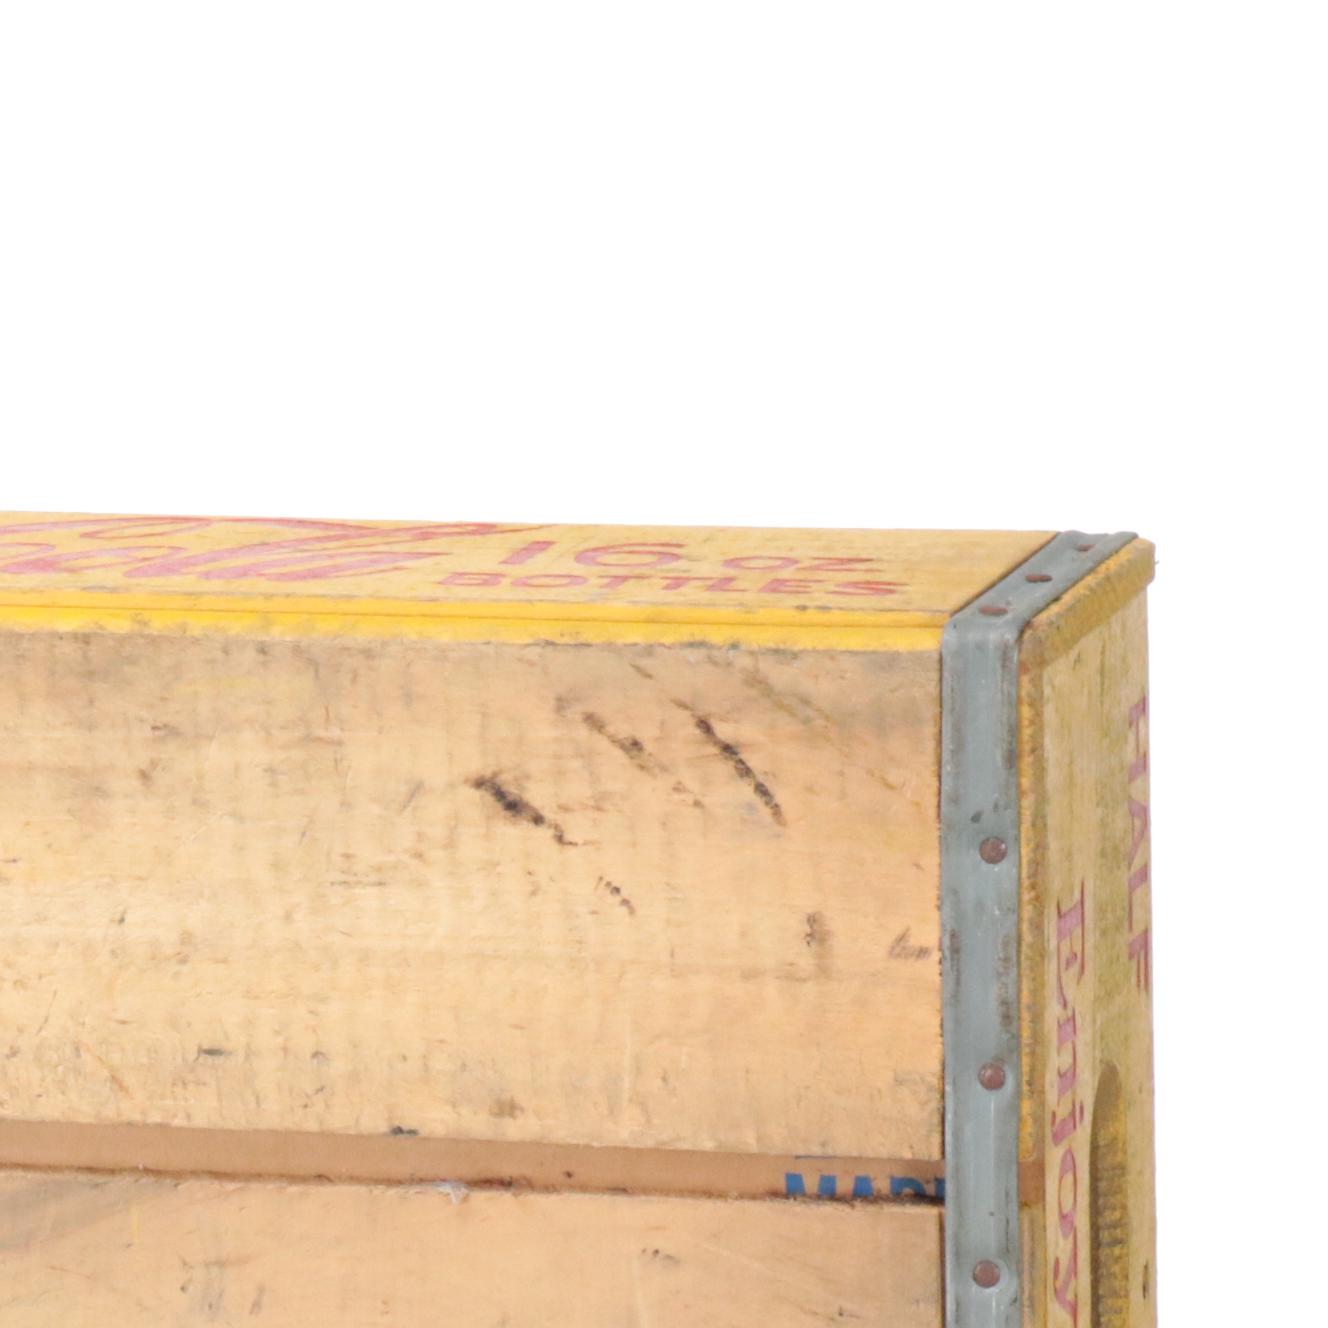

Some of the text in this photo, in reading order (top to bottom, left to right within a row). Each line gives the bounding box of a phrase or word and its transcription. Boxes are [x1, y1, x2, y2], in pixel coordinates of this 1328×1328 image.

[500, 540, 686, 569] 16
[436, 571, 909, 597] BOTTLES
[1127, 696, 1150, 994] HALF
